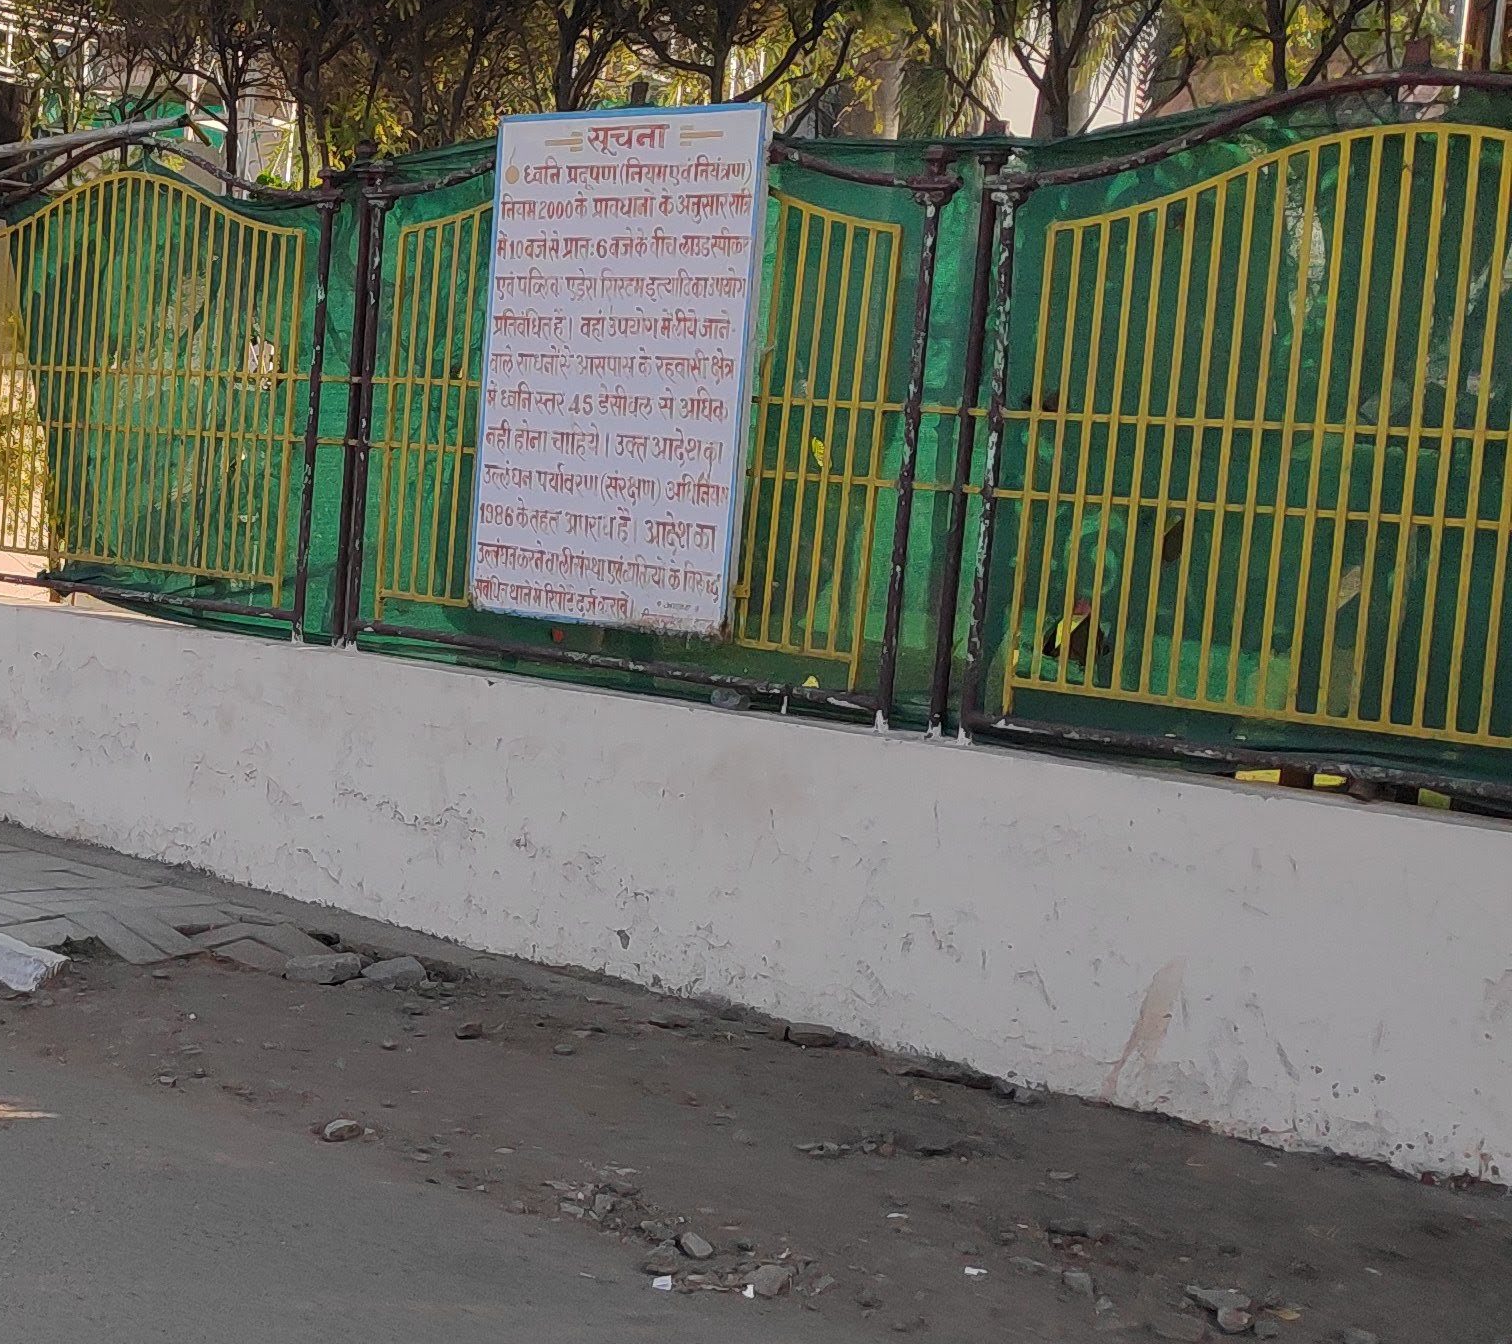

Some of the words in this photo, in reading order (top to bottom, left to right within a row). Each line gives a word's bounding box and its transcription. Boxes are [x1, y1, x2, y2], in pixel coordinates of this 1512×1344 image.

[587, 124, 670, 156] सूचना
[524, 156, 562, 185] ध्वनि
[566, 163, 619, 190] प्रदूषण
[501, 193, 537, 221] नियम
[538, 200, 572, 220] 2000
[574, 191, 587, 218] के
[658, 188, 674, 216] के
[509, 239, 523, 259] 10
[525, 230, 547, 260] बजे
[548, 230, 560, 261] से
[596, 238, 607, 258] 6
[609, 227, 634, 258] बजे
[635, 227, 648, 258] के
[495, 271, 515, 300] एवं
[711, 348, 734, 385] क्षेत्र
[500, 381, 534, 412] ध्वनि
[534, 391, 565, 416] स्तर
[568, 393, 593, 416] 45
[658, 387, 676, 420] से
[679, 386, 729, 423] अधिक
[515, 419, 548, 453] होना
[615, 433, 649, 463] उक्त
[651, 427, 701, 467] आदेश
[536, 462, 598, 497] पर्यावरण
[480, 503, 514, 527] 1986
[516, 496, 528, 528] के
[529, 509, 562, 535] तहत
[645, 511, 692, 556] आदेश
[693, 523, 717, 553] का
[668, 559, 681, 590] के
